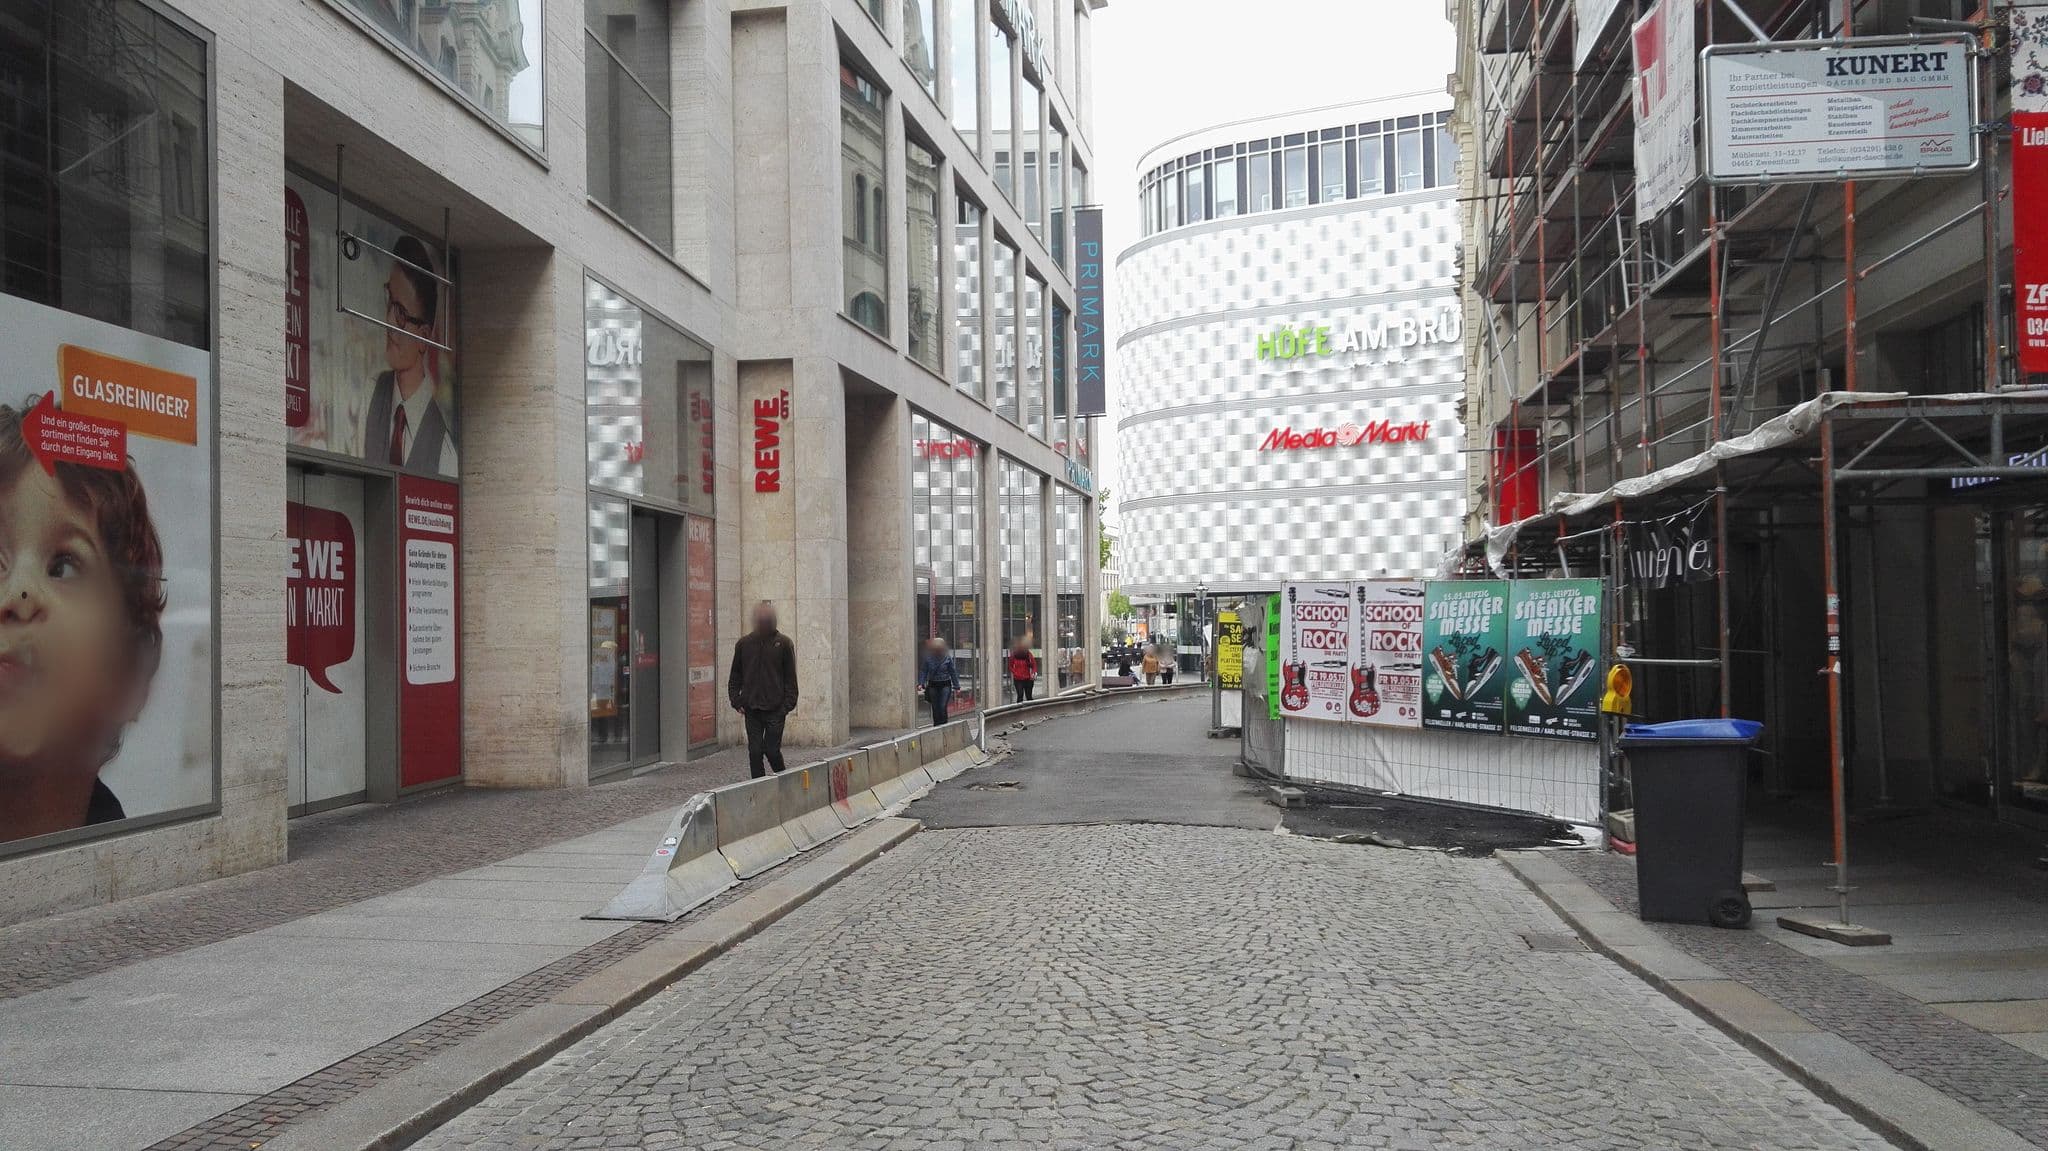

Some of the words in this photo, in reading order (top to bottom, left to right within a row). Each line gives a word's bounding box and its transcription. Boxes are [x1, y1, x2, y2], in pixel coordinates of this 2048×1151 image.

[1826, 52, 1948, 76] KUNERT
[1729, 74, 1741, 82] Ihr
[1745, 73, 1777, 81] Partner
[1729, 81, 1818, 92] Komplettleistungen
[1081, 241, 1100, 382] PRIMARK
[1257, 325, 1333, 361] HÖFE
[1340, 320, 1390, 353] AM
[72, 374, 190, 419] GLASREINIGER?
[41, 415, 55, 427] Und
[56, 418, 67, 428] ein
[68, 420, 91, 433] großes
[92, 425, 121, 438] Drogerie-
[1259, 427, 1338, 451] Media
[1354, 419, 1431, 445] Markt
[41, 429, 76, 442] sortiment
[76, 434, 98, 446] finden
[99, 437, 110, 448] Sie
[754, 397, 780, 493] REWE
[41, 441, 61, 453] durch
[62, 445, 75, 455] den
[76, 446, 104, 461] Eingang
[103, 452, 119, 462] links.
[688, 519, 711, 542] REWE
[306, 587, 344, 626] MARKT
[1296, 605, 1347, 621] SCHOOL
[1366, 606, 1422, 622] SCHOOL
[1430, 596, 1504, 620] SNEAKER
[1514, 596, 1597, 620] SNEAKER
[1229, 624, 1242, 634] SA
[1440, 616, 1490, 636] MESSE
[1527, 616, 1582, 637] MESSE
[1302, 630, 1346, 650] ROCK
[1371, 631, 1421, 651] ROCK
